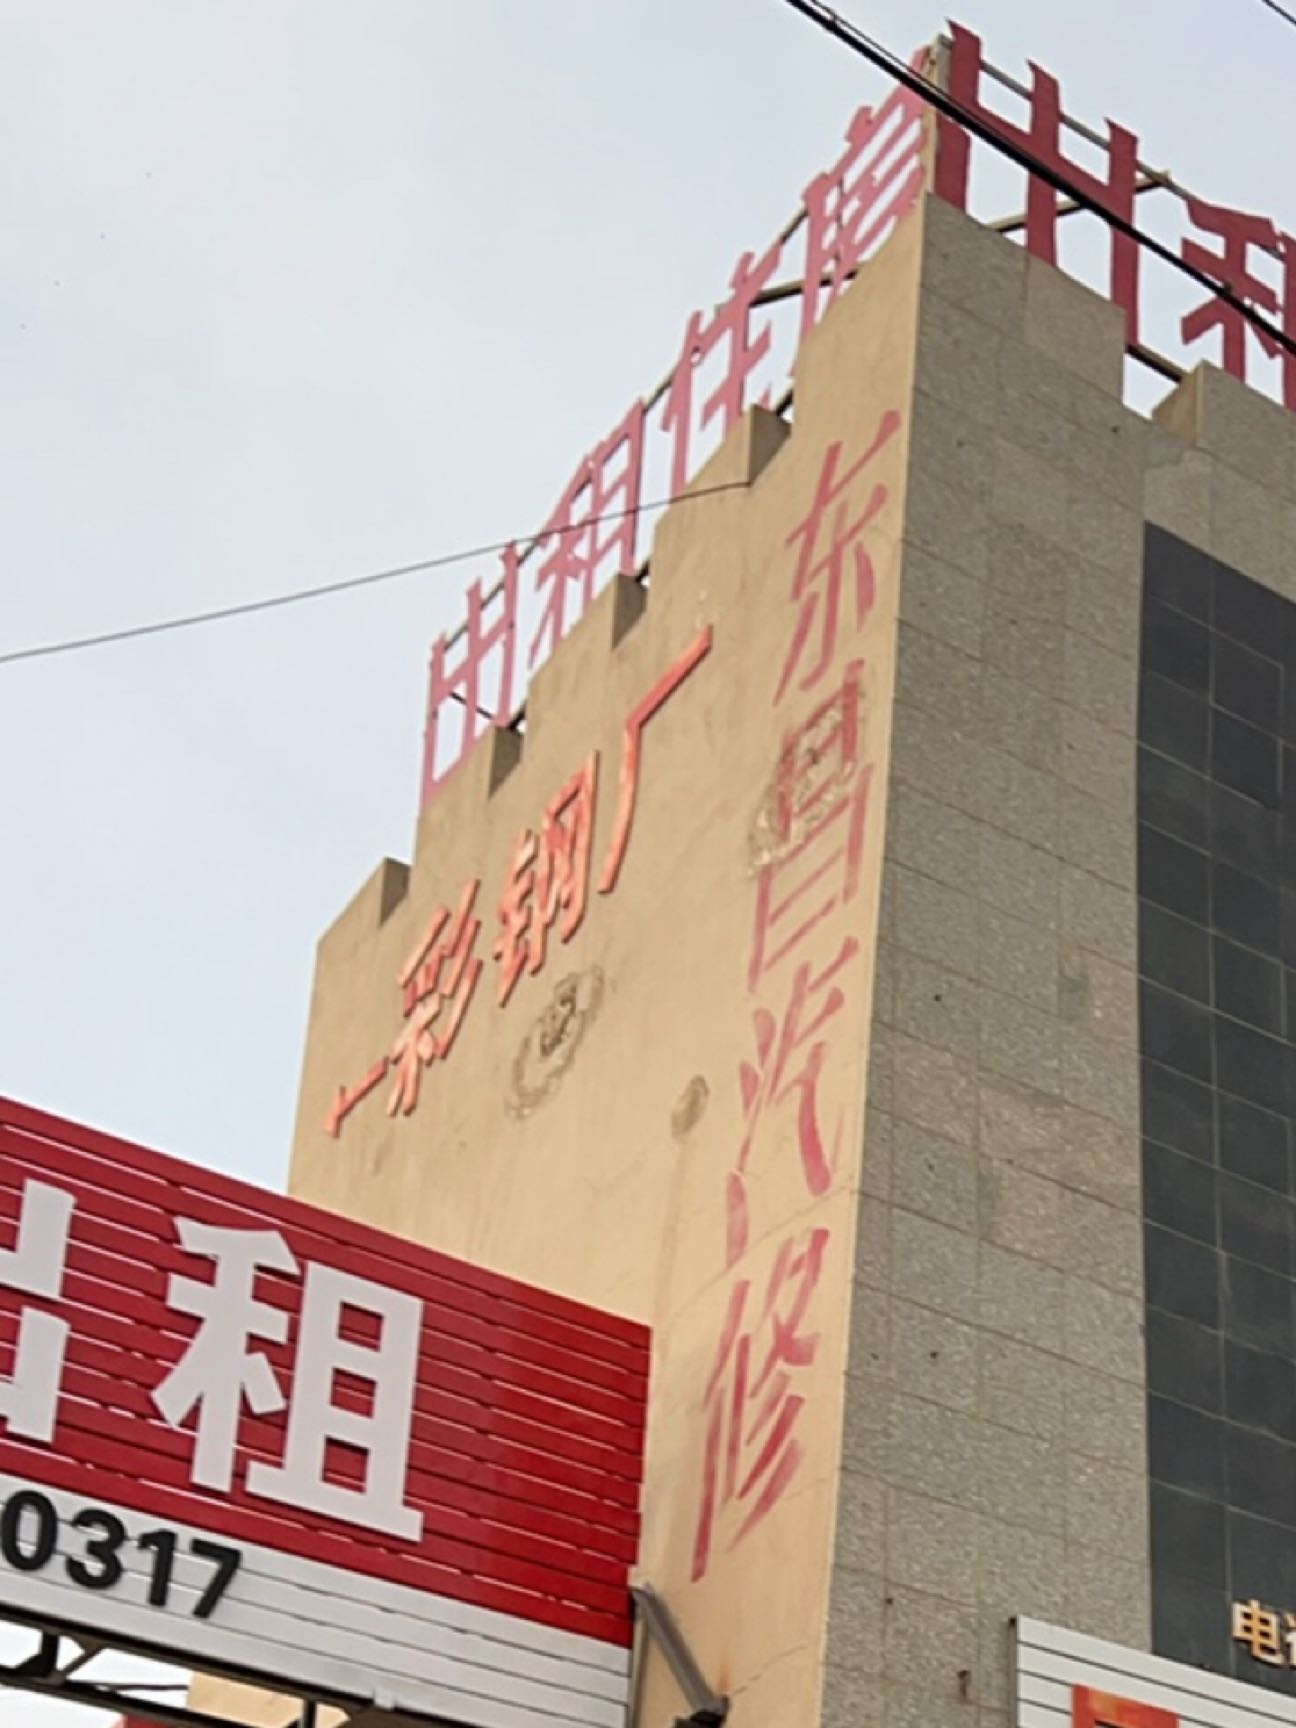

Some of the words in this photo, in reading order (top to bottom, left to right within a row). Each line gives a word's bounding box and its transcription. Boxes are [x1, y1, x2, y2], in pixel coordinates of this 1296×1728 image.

[694, 409, 901, 1583] 东昌汽修
[0, 1490, 241, 1619] 0317
